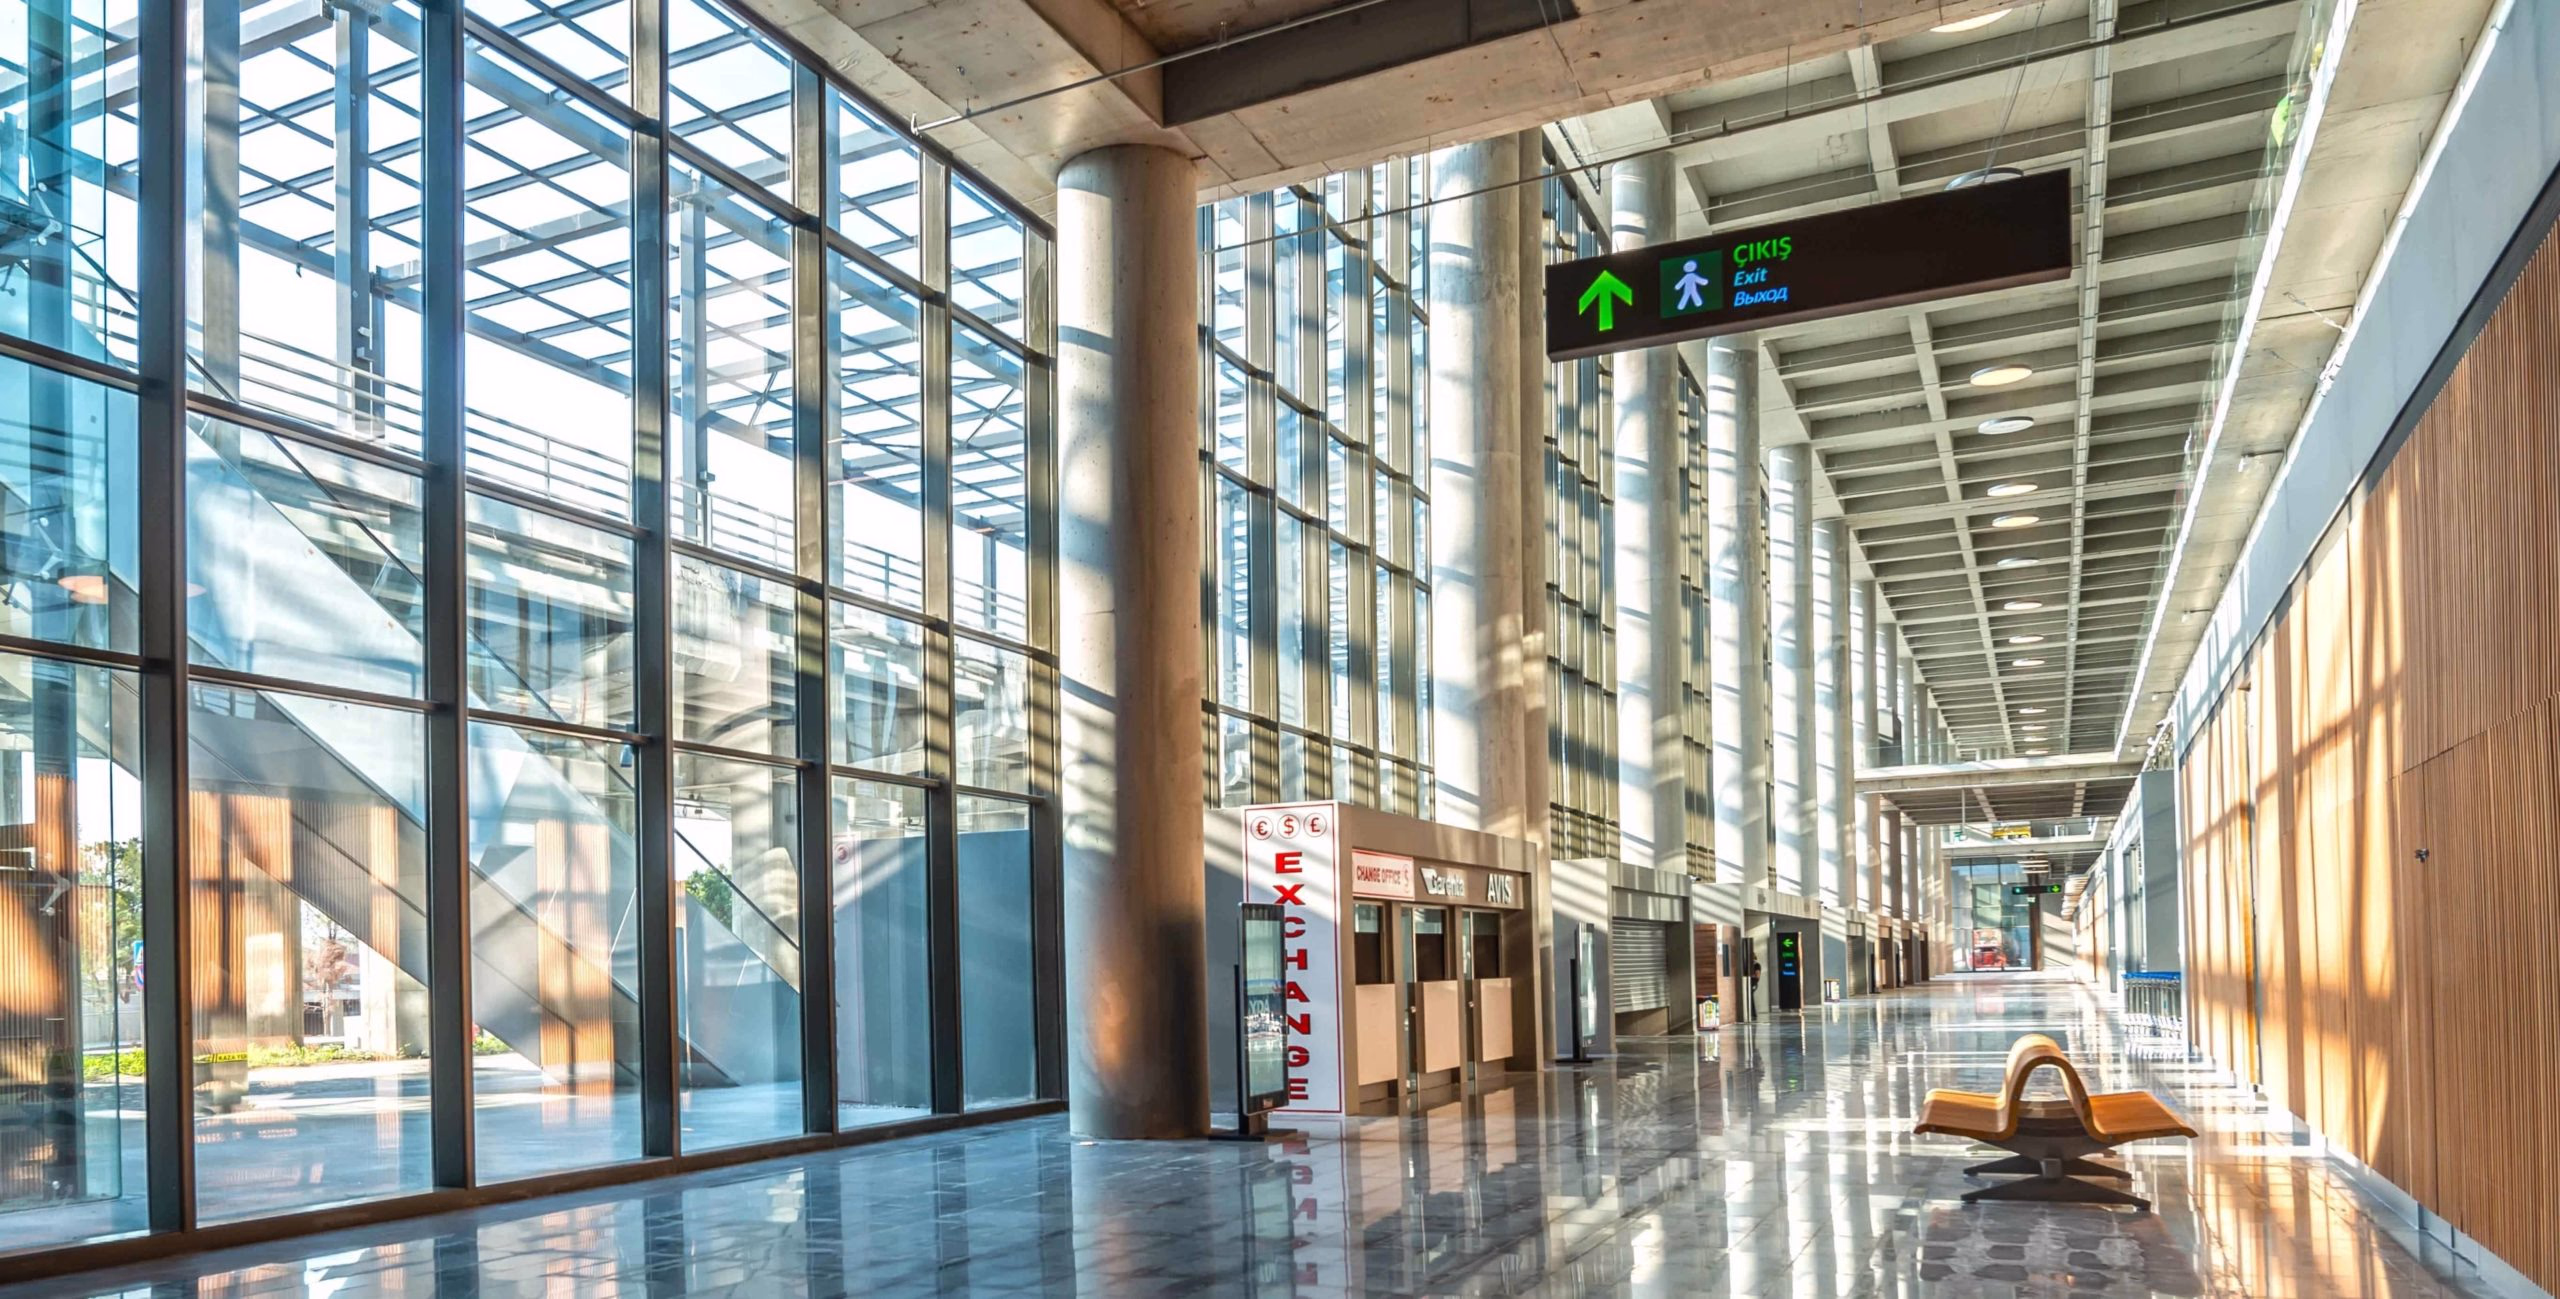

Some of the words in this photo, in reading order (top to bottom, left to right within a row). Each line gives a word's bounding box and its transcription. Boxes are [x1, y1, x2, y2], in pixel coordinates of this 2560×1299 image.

[1733, 236, 1792, 268] ÇIKIŞ
[1733, 267, 1768, 287] Exit
[1733, 287, 1788, 307] Выход
[1357, 865, 1381, 883] CHANGE
[1382, 868, 1401, 885] OFFICE
[1487, 873, 1512, 904] AVIS
[1272, 851, 1311, 1101] EXCHANGE
